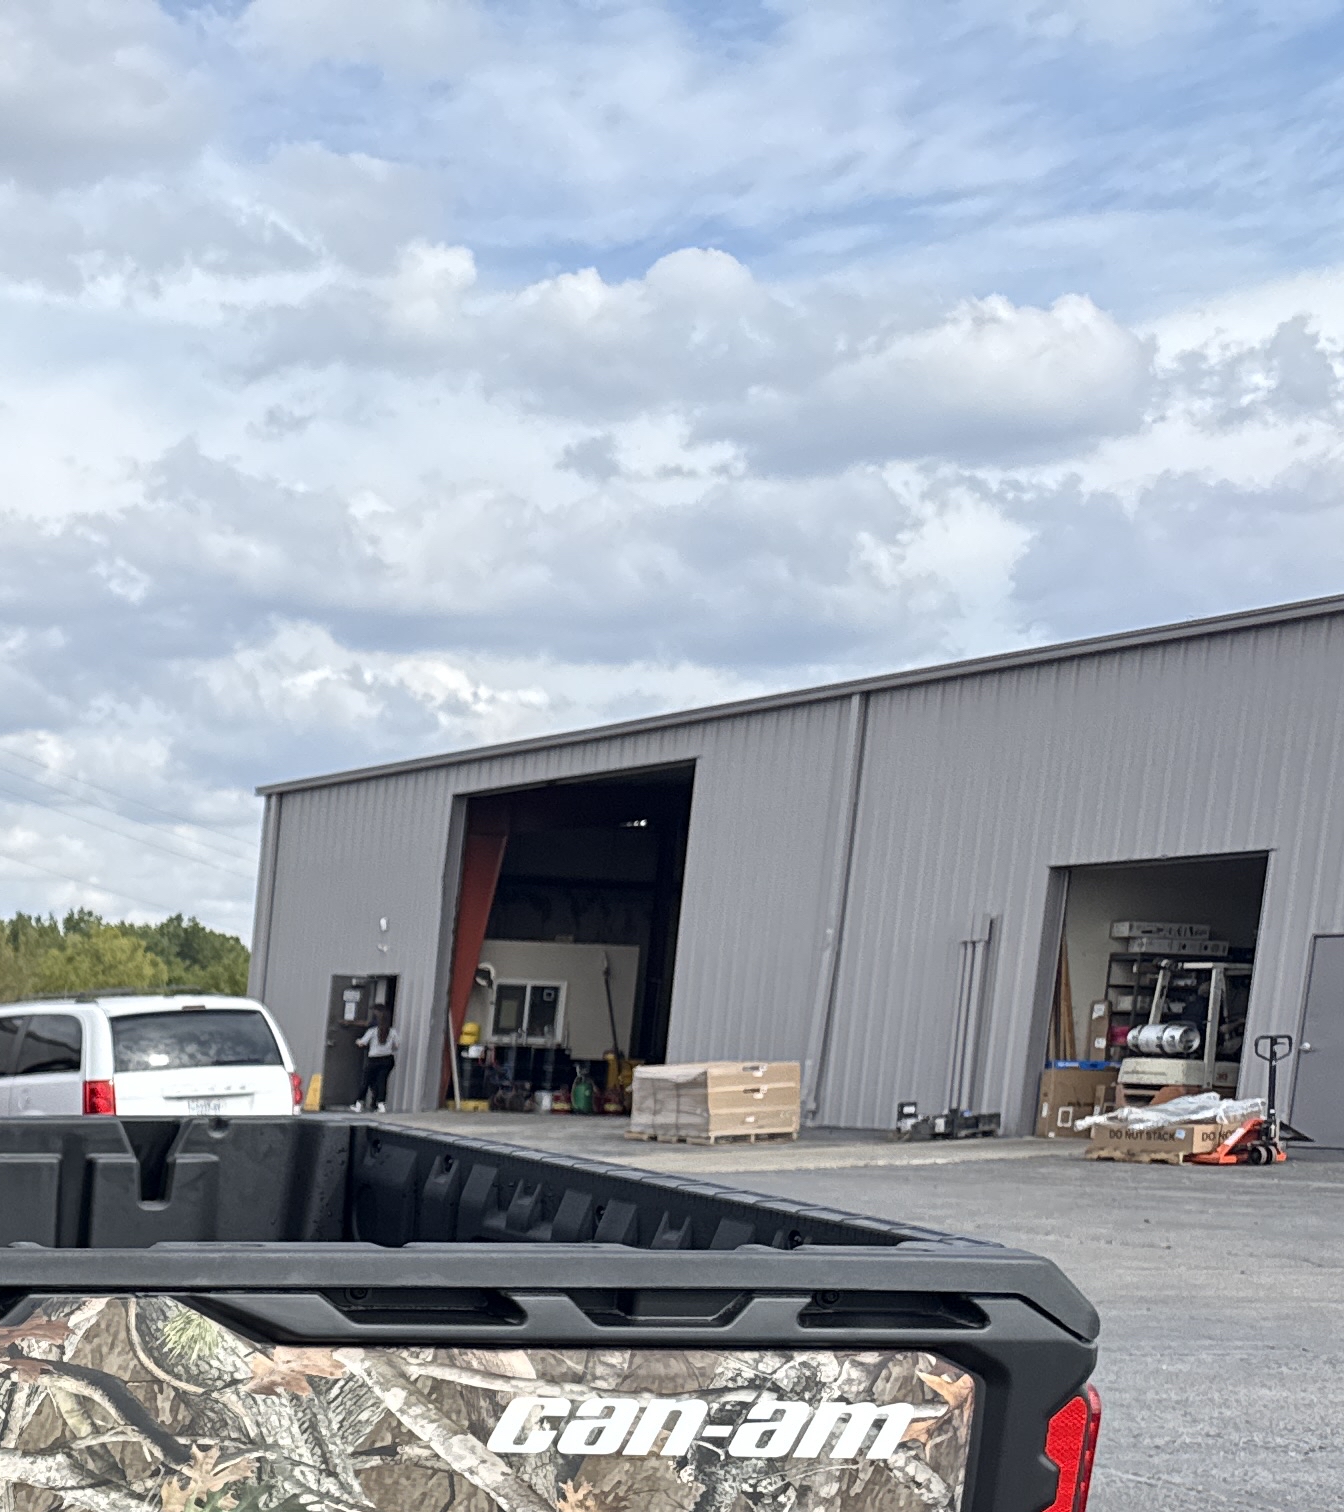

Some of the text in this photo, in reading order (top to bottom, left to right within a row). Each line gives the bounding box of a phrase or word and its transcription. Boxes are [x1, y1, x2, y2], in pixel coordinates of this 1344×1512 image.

[1109, 1129, 1123, 1139] DO
[1146, 1130, 1176, 1142] STACK
[1202, 1132, 1216, 1142] DO
